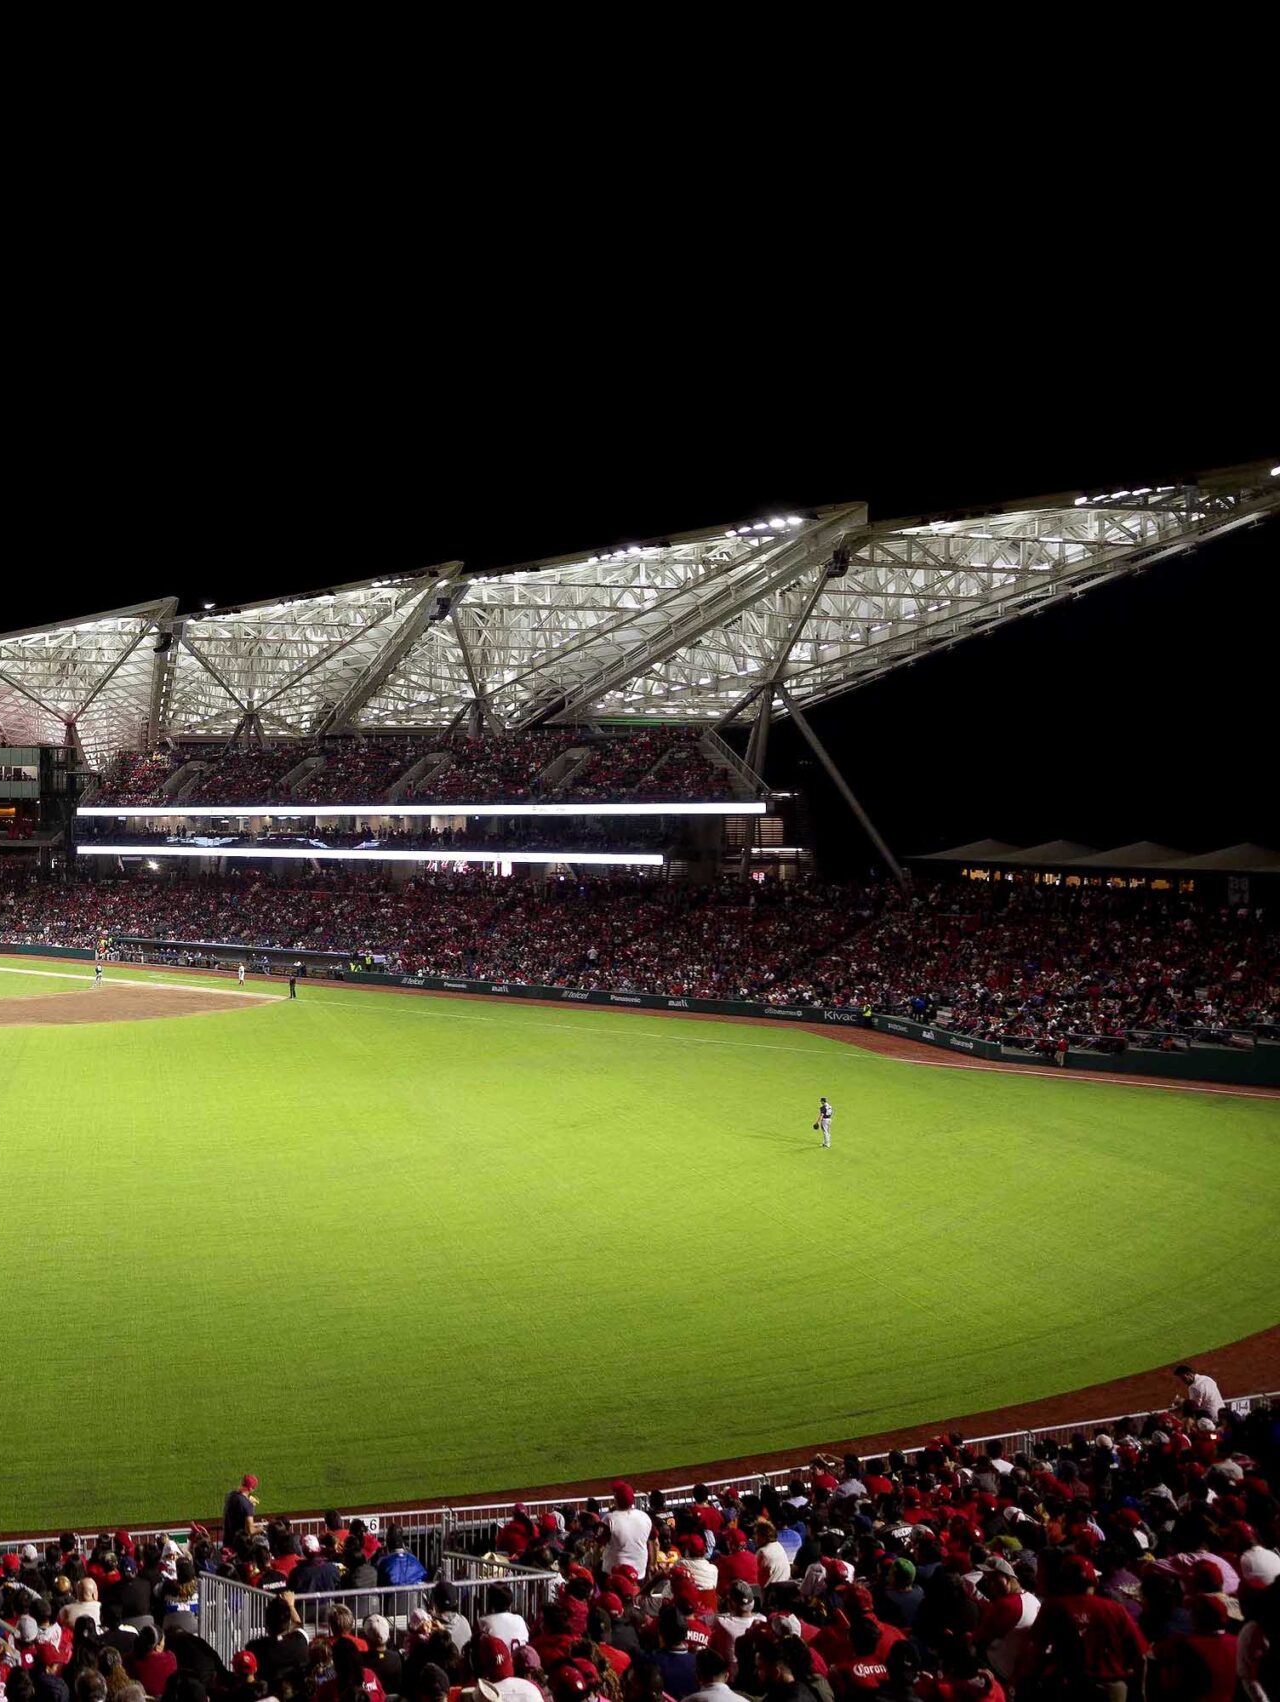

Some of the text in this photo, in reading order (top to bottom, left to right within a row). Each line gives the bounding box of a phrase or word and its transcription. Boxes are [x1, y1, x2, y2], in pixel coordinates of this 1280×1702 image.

[824, 1010, 857, 1021] Kivac
[686, 1630, 709, 1646] MBOA
[853, 1663, 887, 1678] Coron
